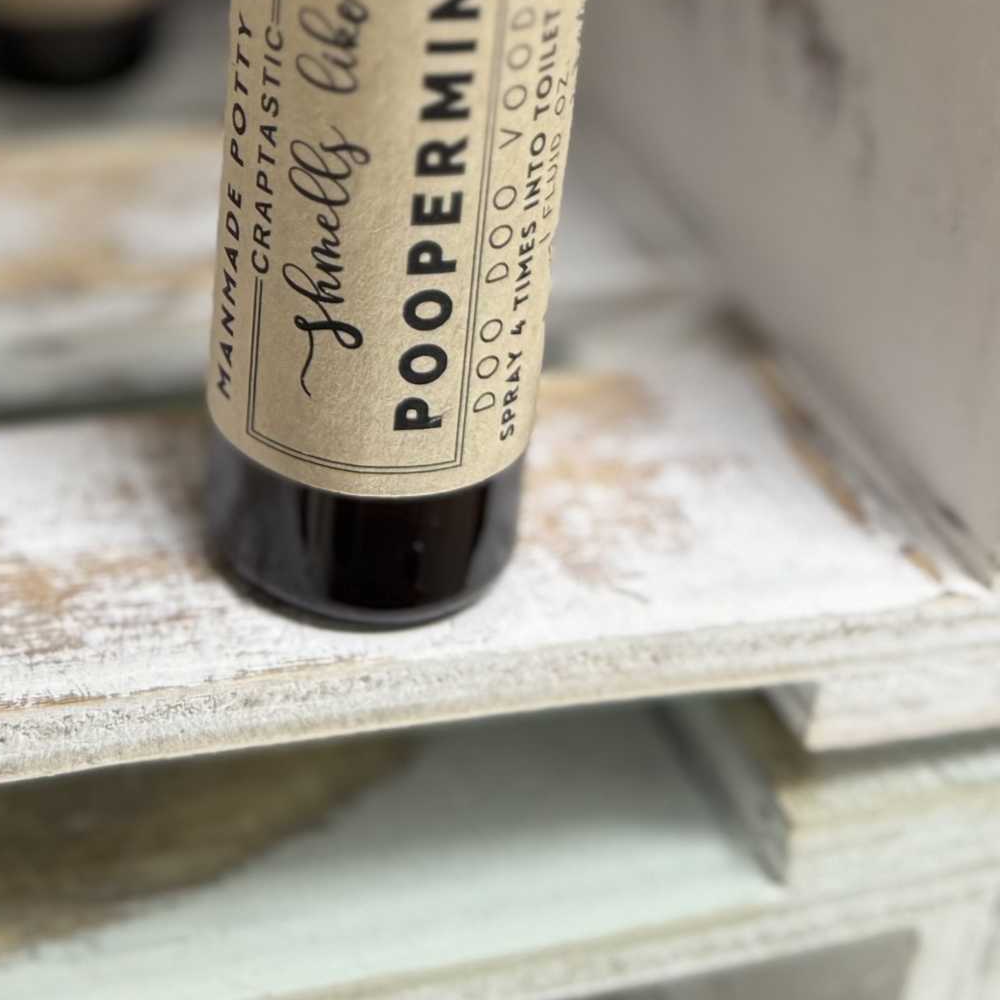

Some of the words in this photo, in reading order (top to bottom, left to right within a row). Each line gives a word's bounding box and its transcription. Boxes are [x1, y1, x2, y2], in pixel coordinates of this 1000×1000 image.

[534, 9, 561, 121] TOILET
[251, 25, 285, 275] CRAPTASTIC
[524, 132, 547, 212] INTO
[217, 183, 242, 399] MANMADE
[230, 12, 252, 167] POTTY
[485, 185, 518, 284] DOO
[513, 221, 537, 312] TIMES
[473, 318, 503, 412] DOO
[511, 319, 526, 335] 4
[500, 350, 522, 440] SPRAY
